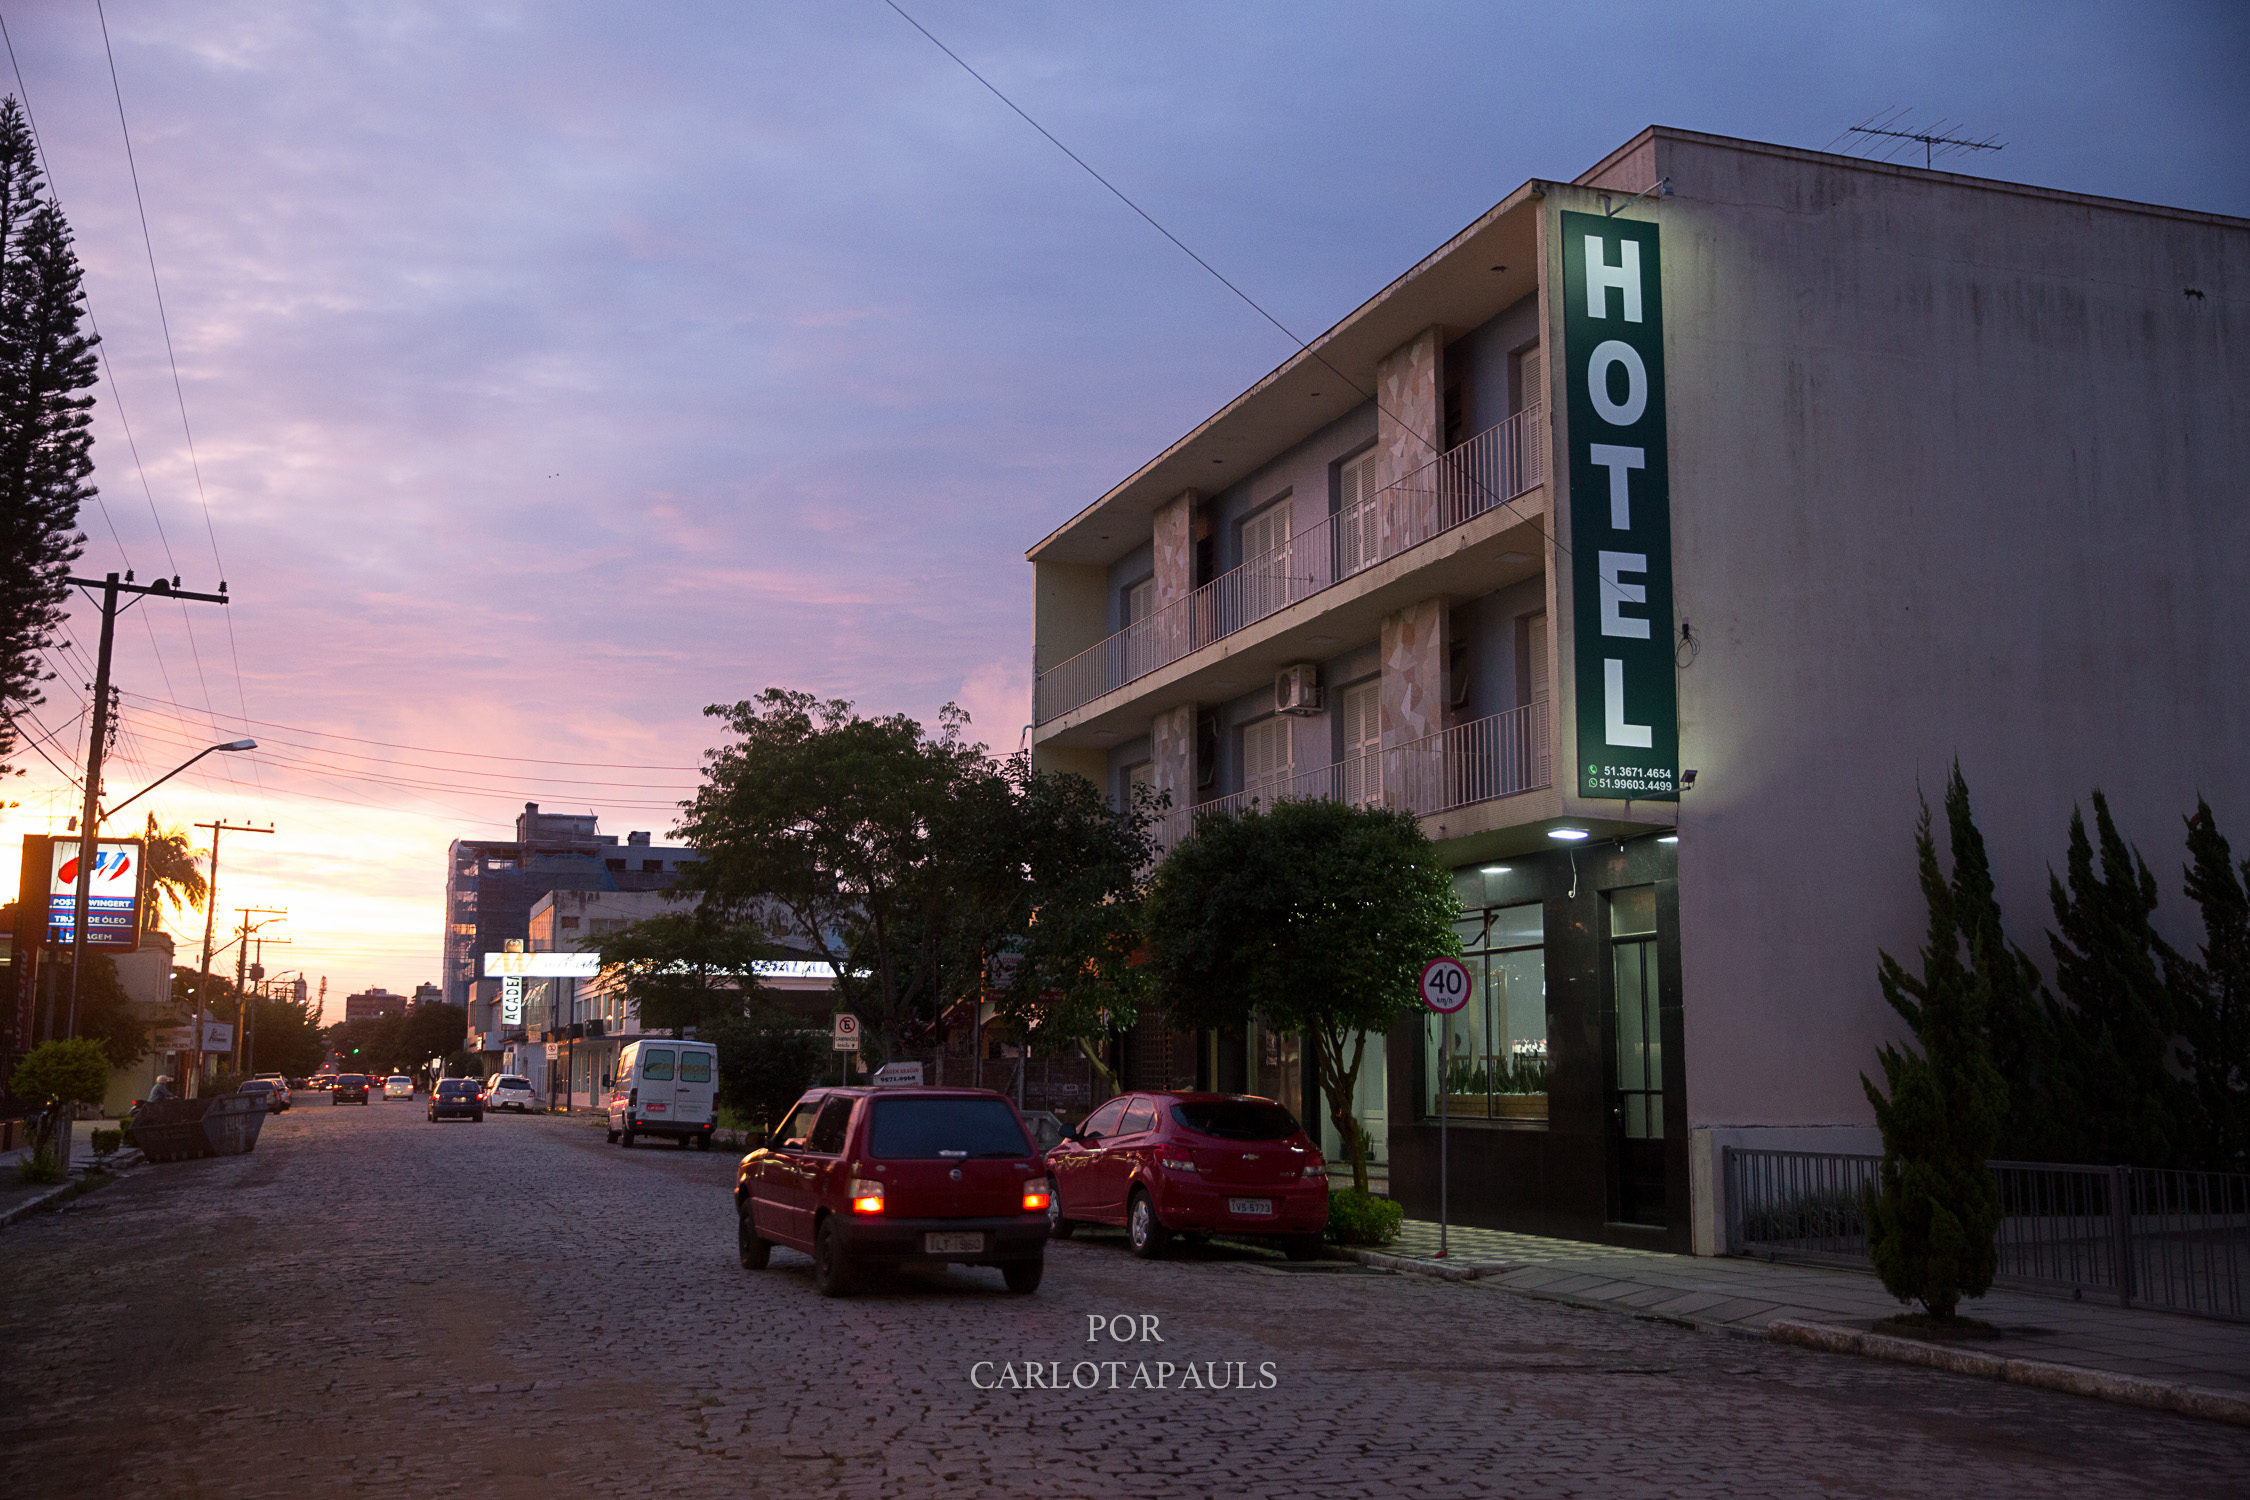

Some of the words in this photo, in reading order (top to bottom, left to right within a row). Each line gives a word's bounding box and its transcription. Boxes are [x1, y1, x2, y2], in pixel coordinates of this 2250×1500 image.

[1583, 234, 1653, 749] HOTEL
[1603, 765, 1672, 780] 51.3671.4654
[1599, 778, 1673, 792] 51.99603.4499
[53, 898, 76, 906] POST
[88, 899, 131, 908] WINGERT
[101, 916, 127, 924] ÓLEO
[1428, 969, 1462, 995] 40
[1436, 996, 1453, 1004] km/h
